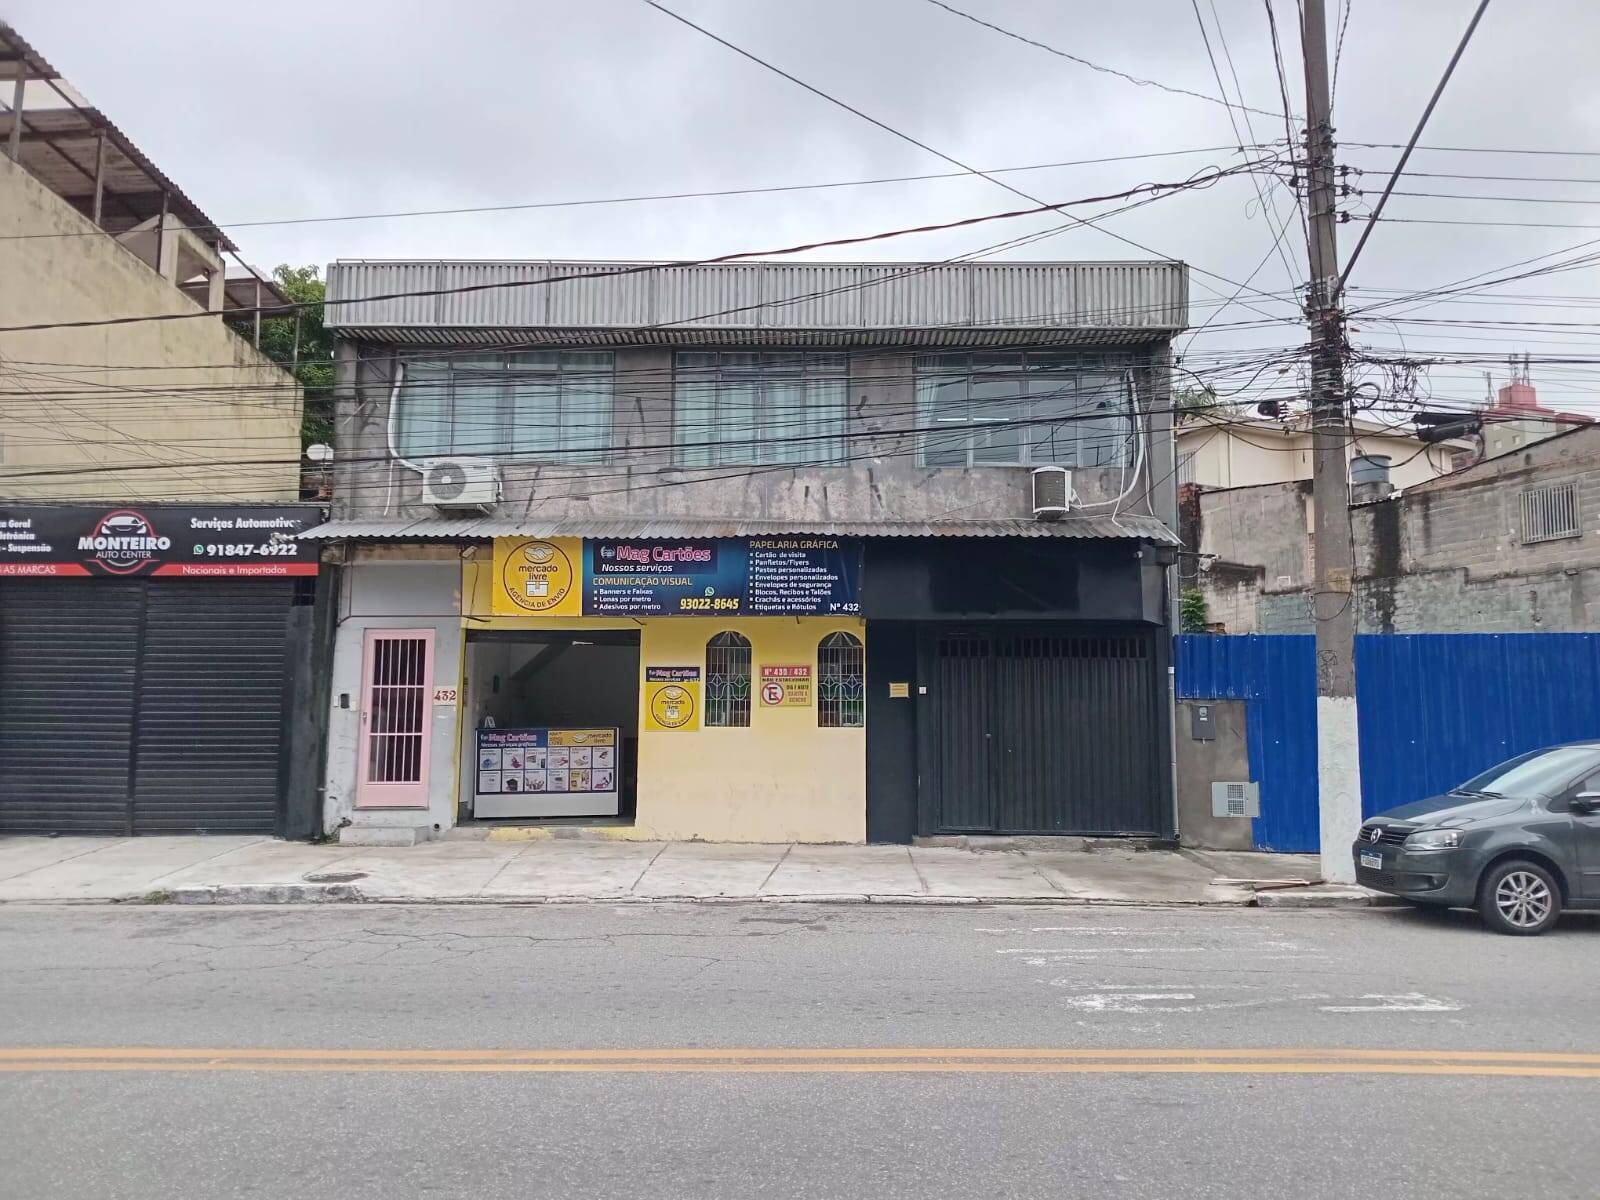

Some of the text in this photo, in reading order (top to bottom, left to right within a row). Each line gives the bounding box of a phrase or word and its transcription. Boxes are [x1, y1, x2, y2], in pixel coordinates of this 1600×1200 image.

[8, 519, 31, 528] Geral
[190, 517, 302, 531] Serviços Automotivo
[77, 536, 171, 550] MONTEIRO
[749, 539, 838, 549] PAPELARIA GRÁFICA
[7, 543, 52, 554] Suspensão
[206, 544, 298, 556] 91847-6922
[616, 546, 711, 563] Mag Cartões
[4, 565, 56, 574] AS MARCAS
[182, 566, 226, 575] Nacionais
[237, 566, 287, 576] Importados
[518, 564, 558, 572] mercado
[602, 563, 673, 573] Nossos serviços
[528, 572, 548, 580] livre
[593, 576, 693, 588] COMUNICAÇÃO VISUAL
[548, 587, 566, 605] ENVIO
[680, 598, 740, 610] 93022-8645
[755, 603, 785, 611] Etiquetas
[842, 603, 859, 611] 432
[434, 690, 456, 701] 432
